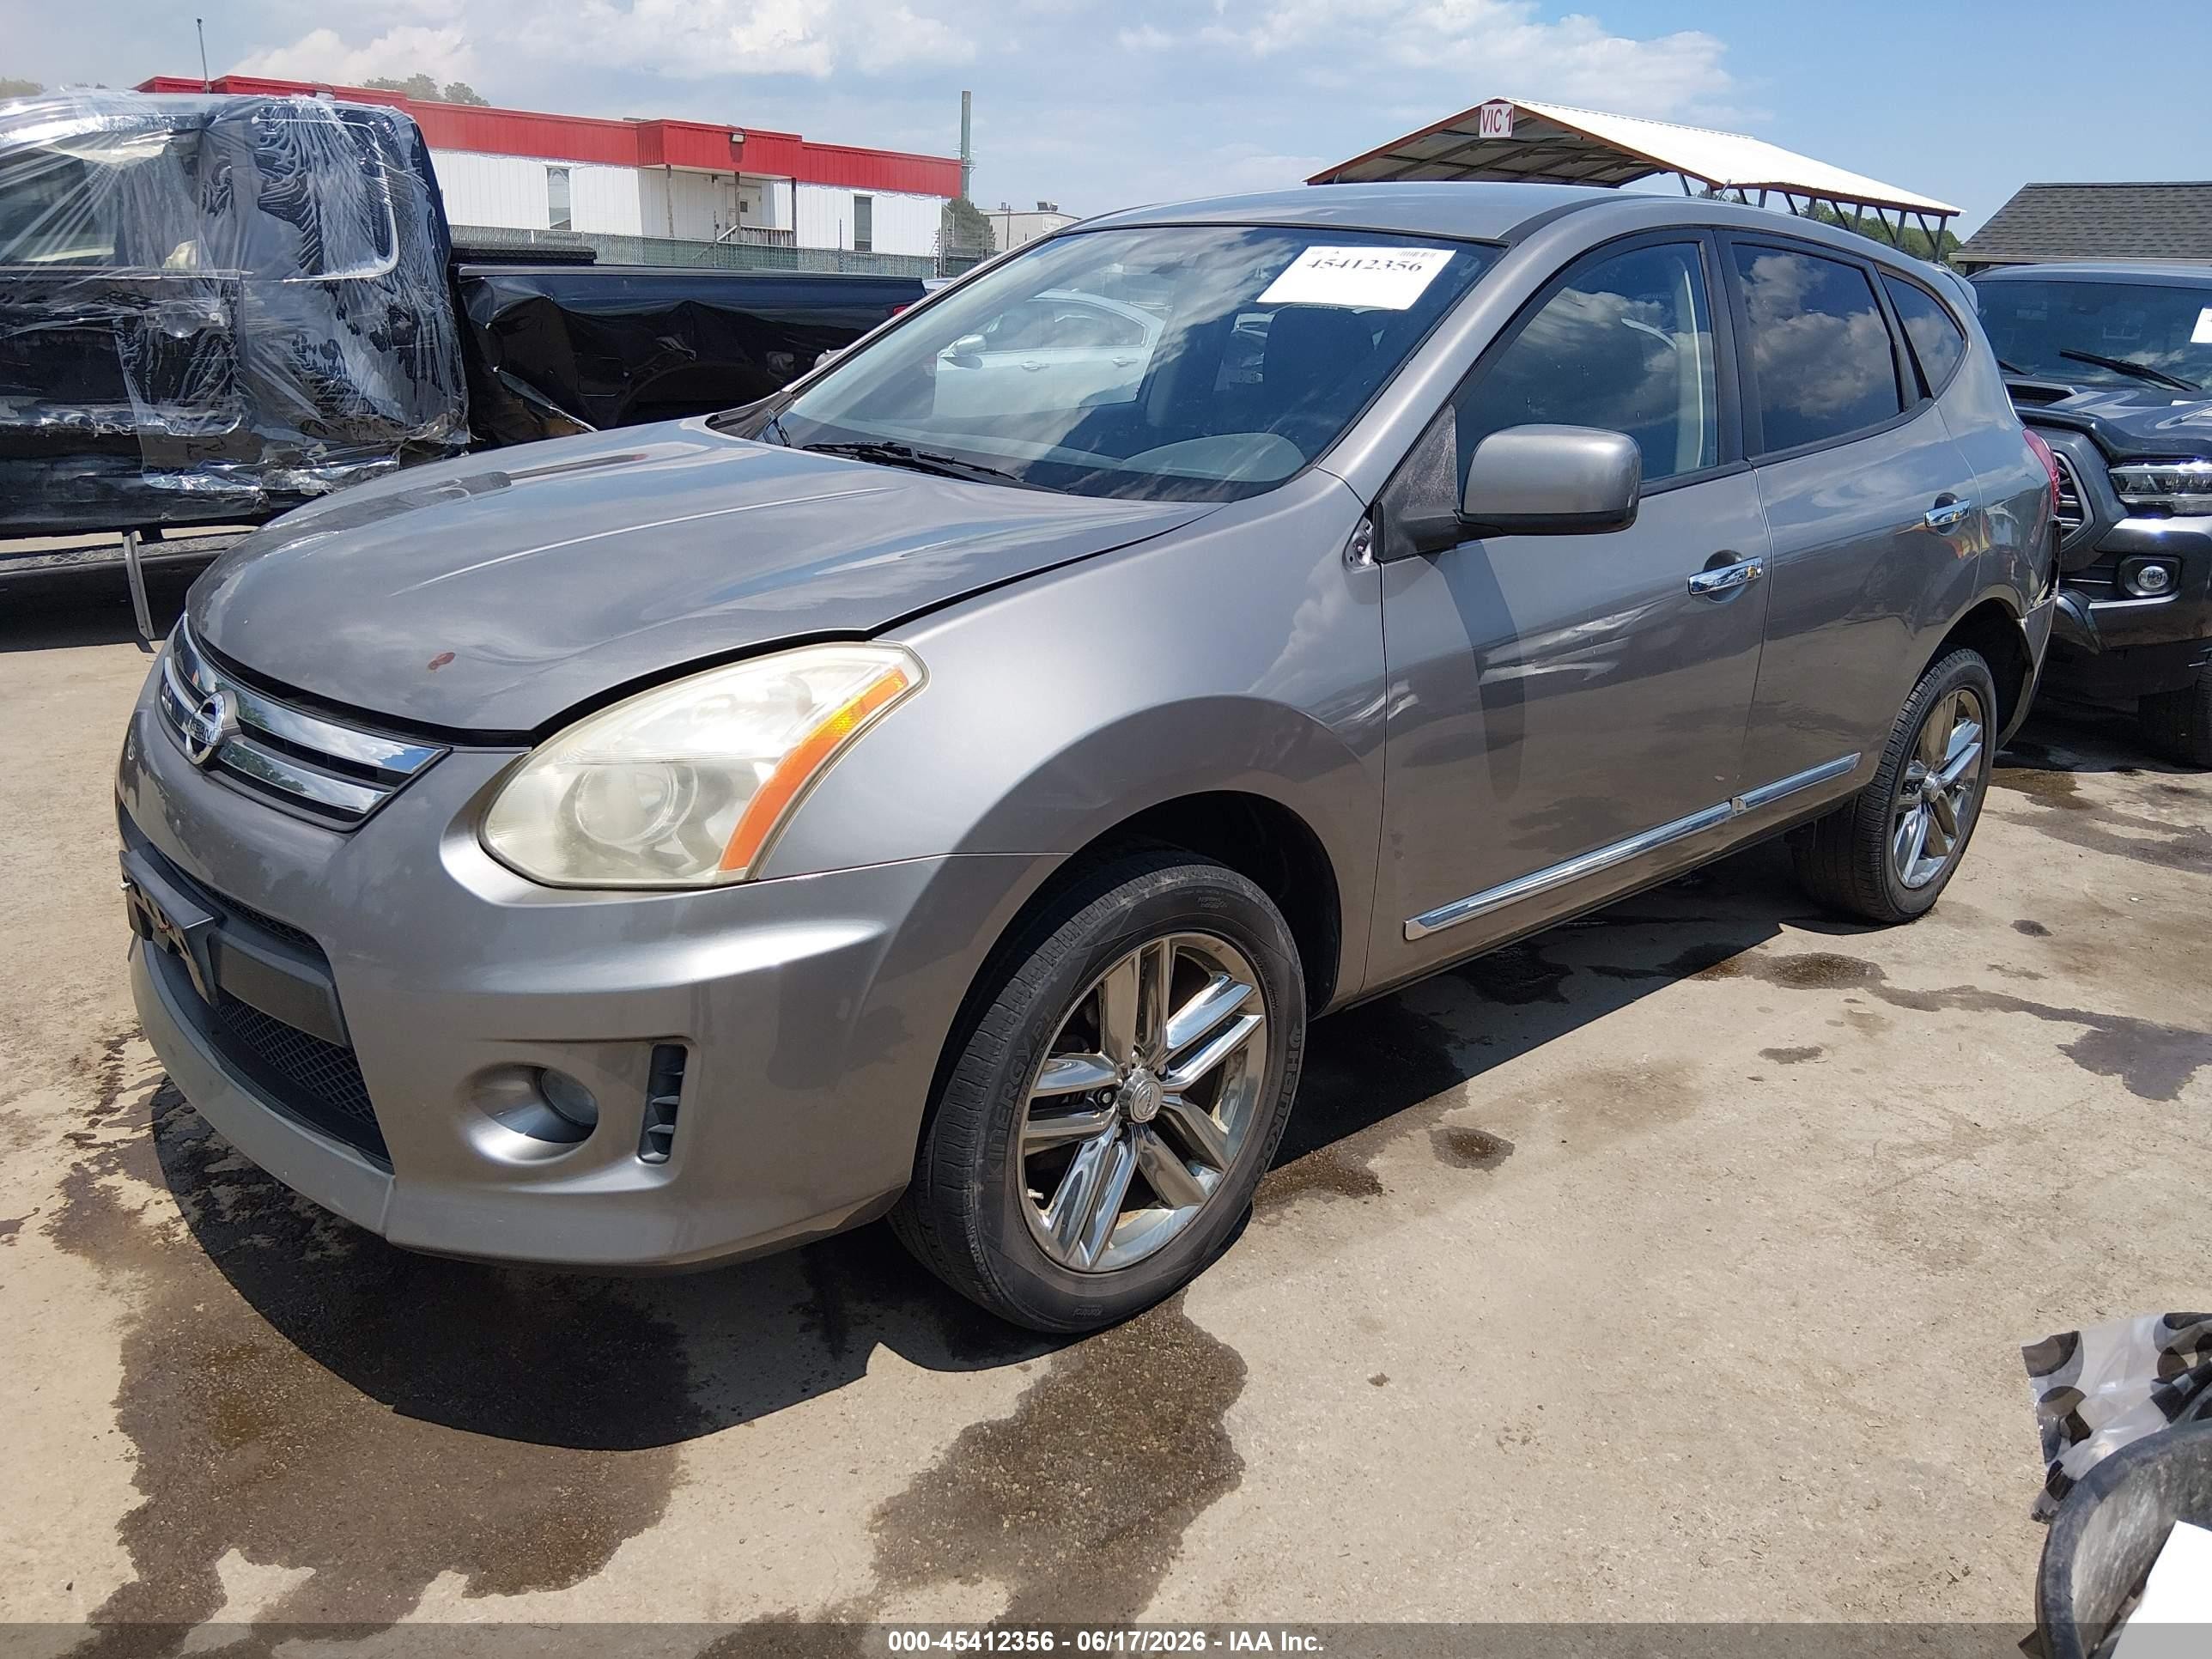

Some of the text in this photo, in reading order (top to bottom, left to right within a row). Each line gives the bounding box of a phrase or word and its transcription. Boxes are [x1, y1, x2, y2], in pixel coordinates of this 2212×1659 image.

[1482, 107, 1513, 133] VIC 1
[1306, 259, 1423, 272] 45412356
